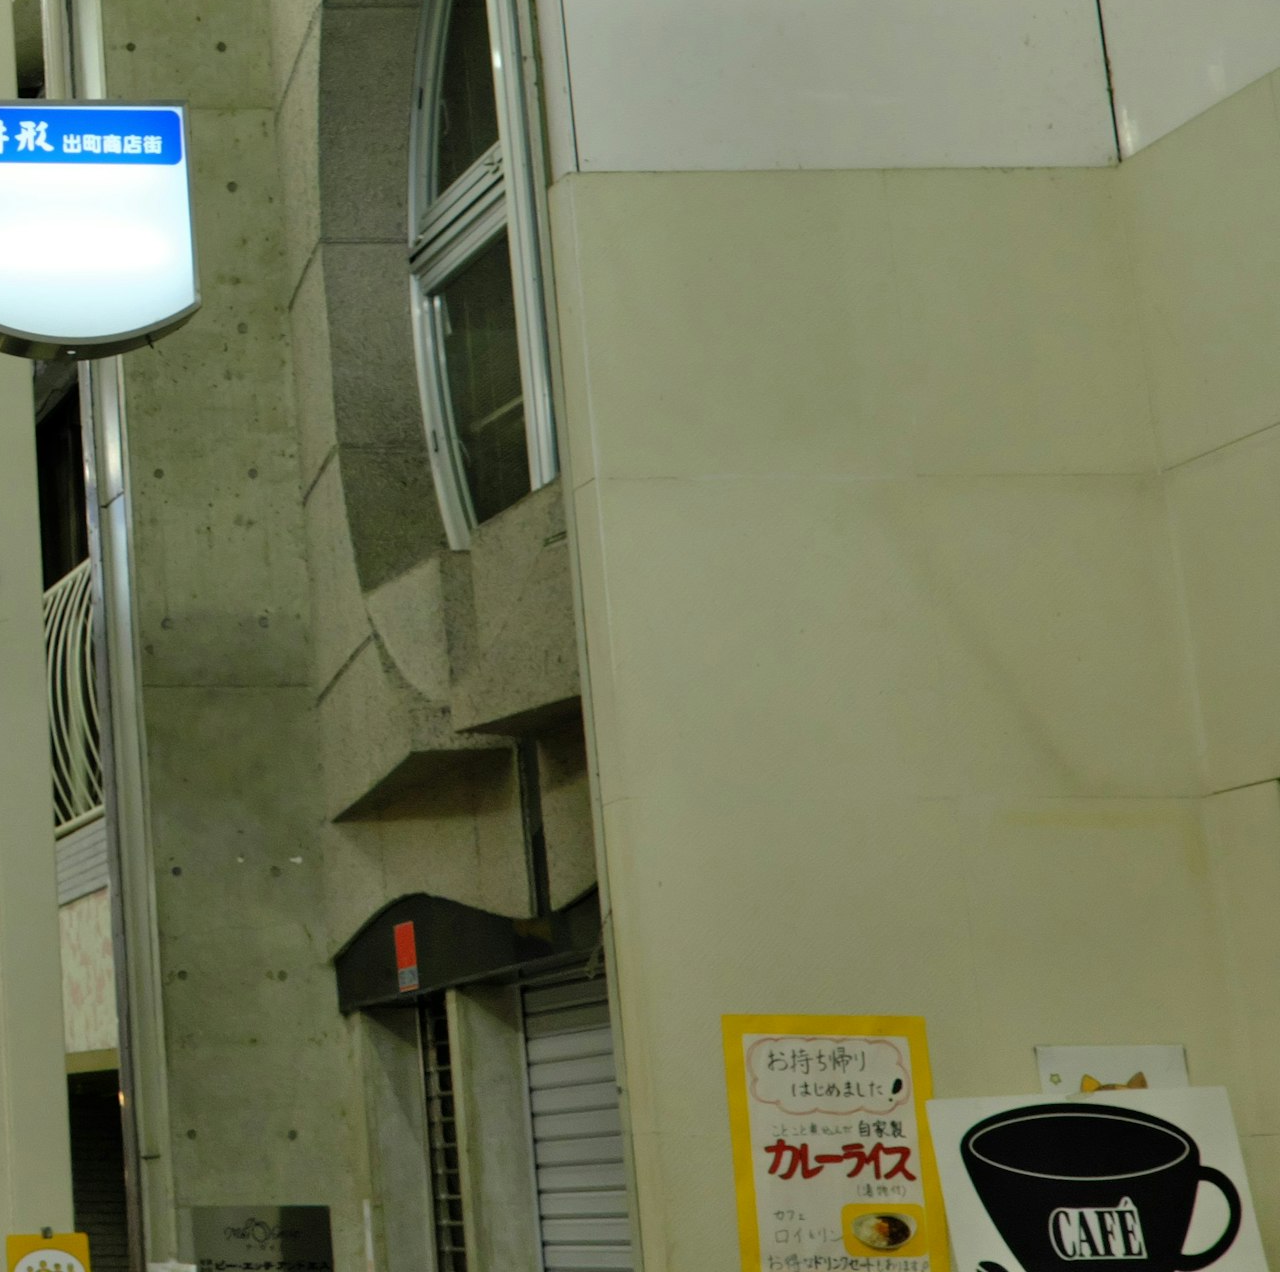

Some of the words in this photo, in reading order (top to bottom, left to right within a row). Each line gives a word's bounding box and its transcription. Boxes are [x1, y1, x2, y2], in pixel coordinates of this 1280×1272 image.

[768, 1047, 866, 1075] お持ち帰り
[765, 1139, 917, 1181] カレーライス
[1052, 1199, 1144, 1258] CAFÉ
